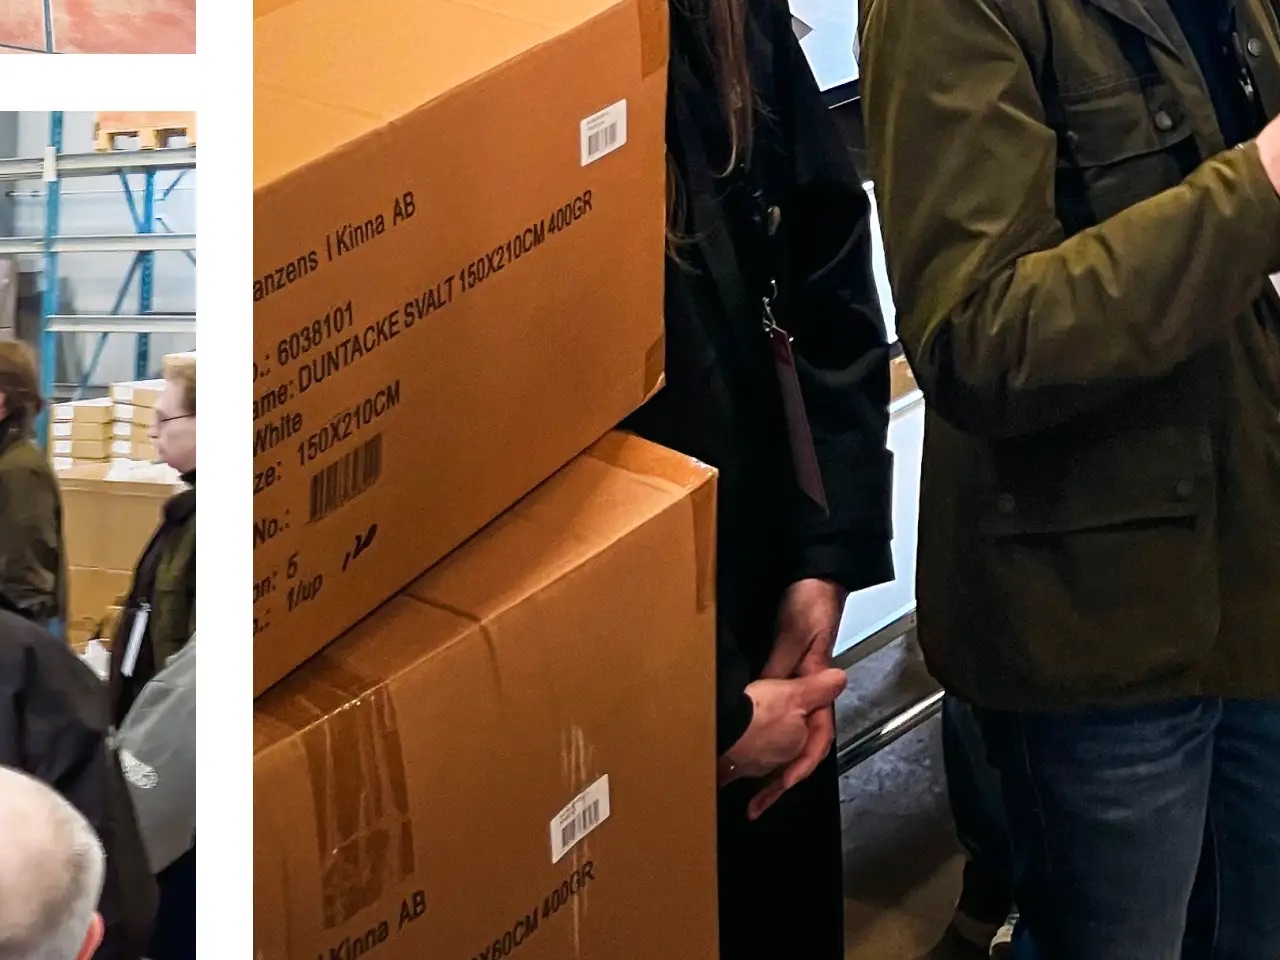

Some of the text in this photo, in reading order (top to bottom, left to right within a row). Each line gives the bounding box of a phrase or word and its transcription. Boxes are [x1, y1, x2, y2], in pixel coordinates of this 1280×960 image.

[335, 213, 386, 257] Kinna
[392, 190, 416, 227] AB
[298, 309, 401, 393] DUNTACKE
[403, 274, 456, 329] SVALT
[459, 218, 546, 293] 150X210CM
[547, 189, 593, 235] 400GR
[277, 299, 354, 367] 6038101
[297, 378, 401, 467] 150X210CM
[397, 889, 426, 931] AB
